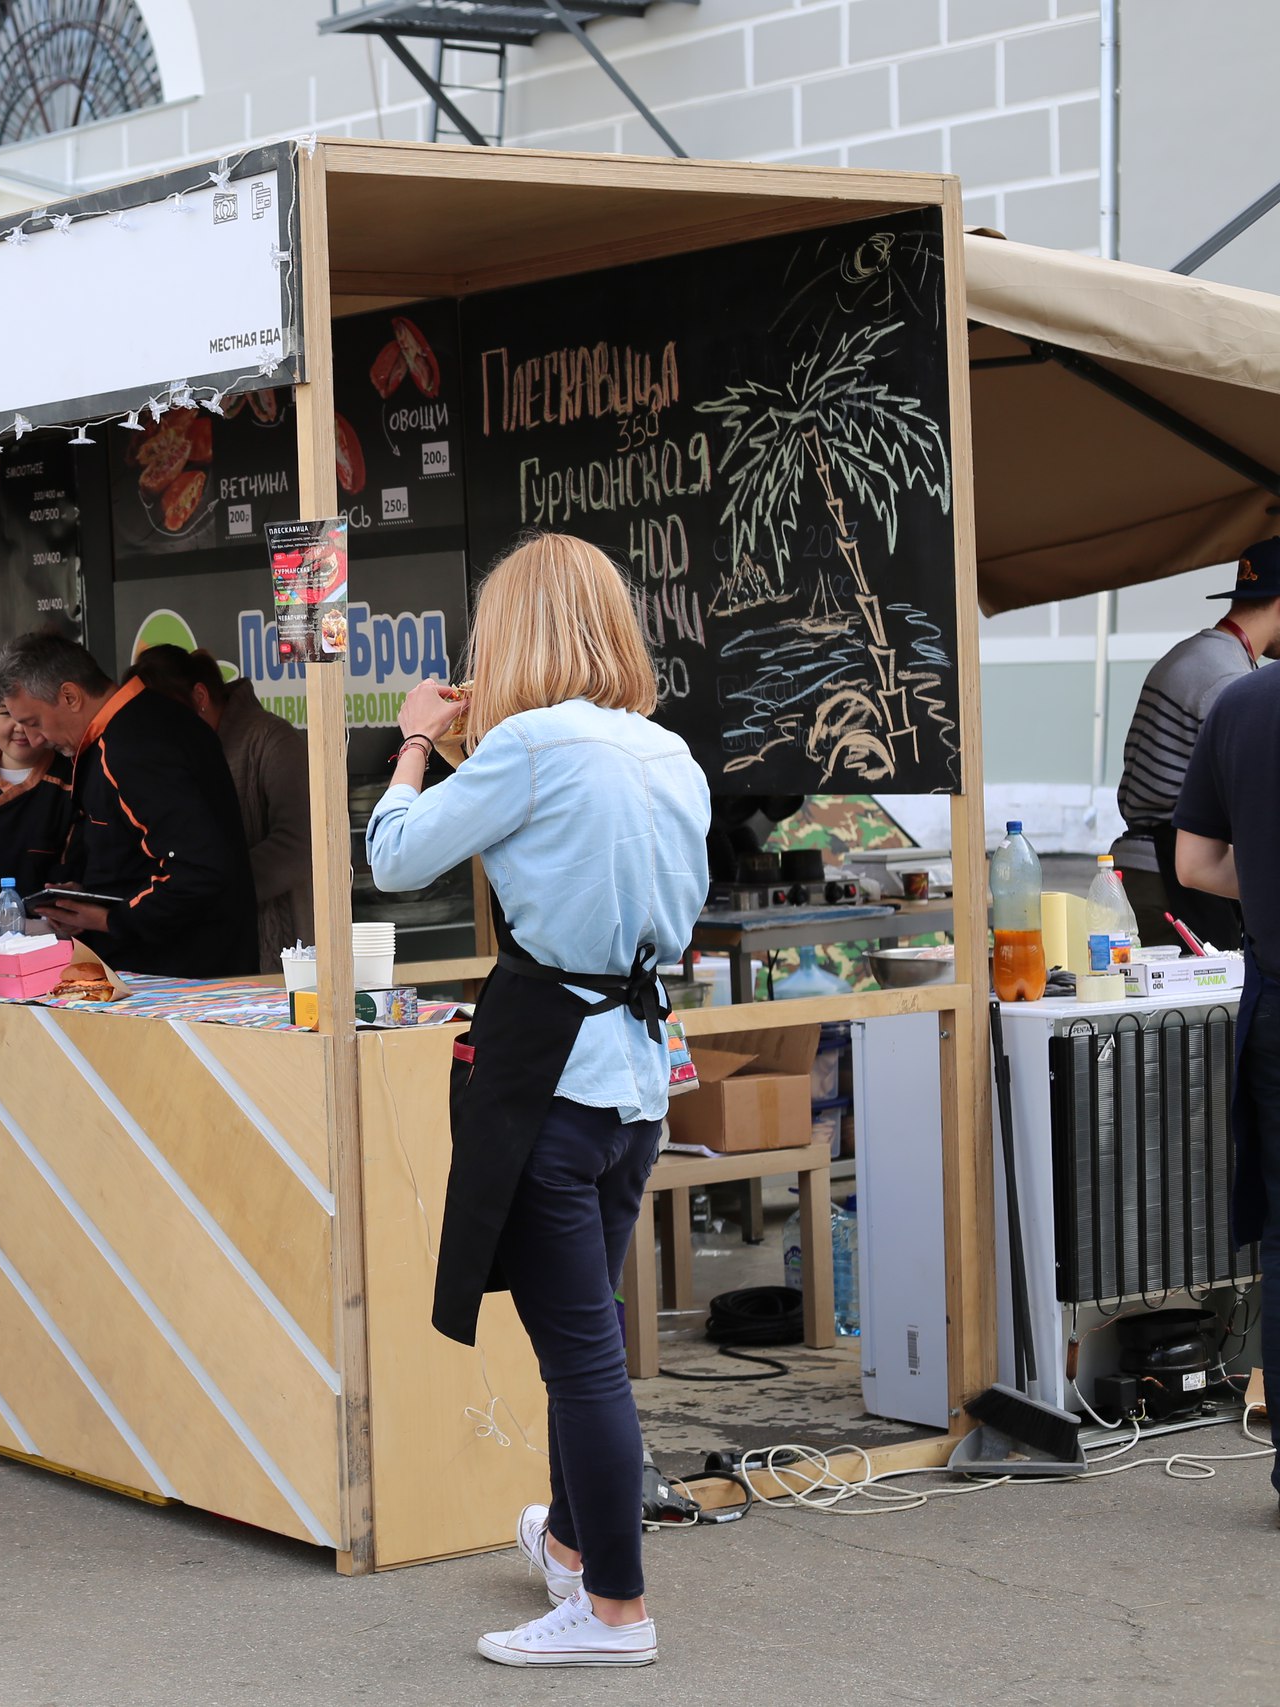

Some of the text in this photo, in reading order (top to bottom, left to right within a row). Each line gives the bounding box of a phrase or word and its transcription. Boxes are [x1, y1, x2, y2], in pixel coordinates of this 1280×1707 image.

[209, 327, 281, 354] МЕСТНАЯ ЕДА
[389, 402, 449, 432] ОВОЩИ
[616, 409, 659, 452] 350
[5, 461, 44, 479] SMOOTHIE
[220, 471, 289, 500] ВЕТЧИНА
[29, 508, 60, 522] 400/500
[268, 525, 309, 535] ПЛЕСКАВИЦА
[629, 514, 689, 582] 400
[33, 552, 61, 565] 300/400
[37, 598, 63, 611] 300/400
[1193, 975, 1228, 987] VINYL
